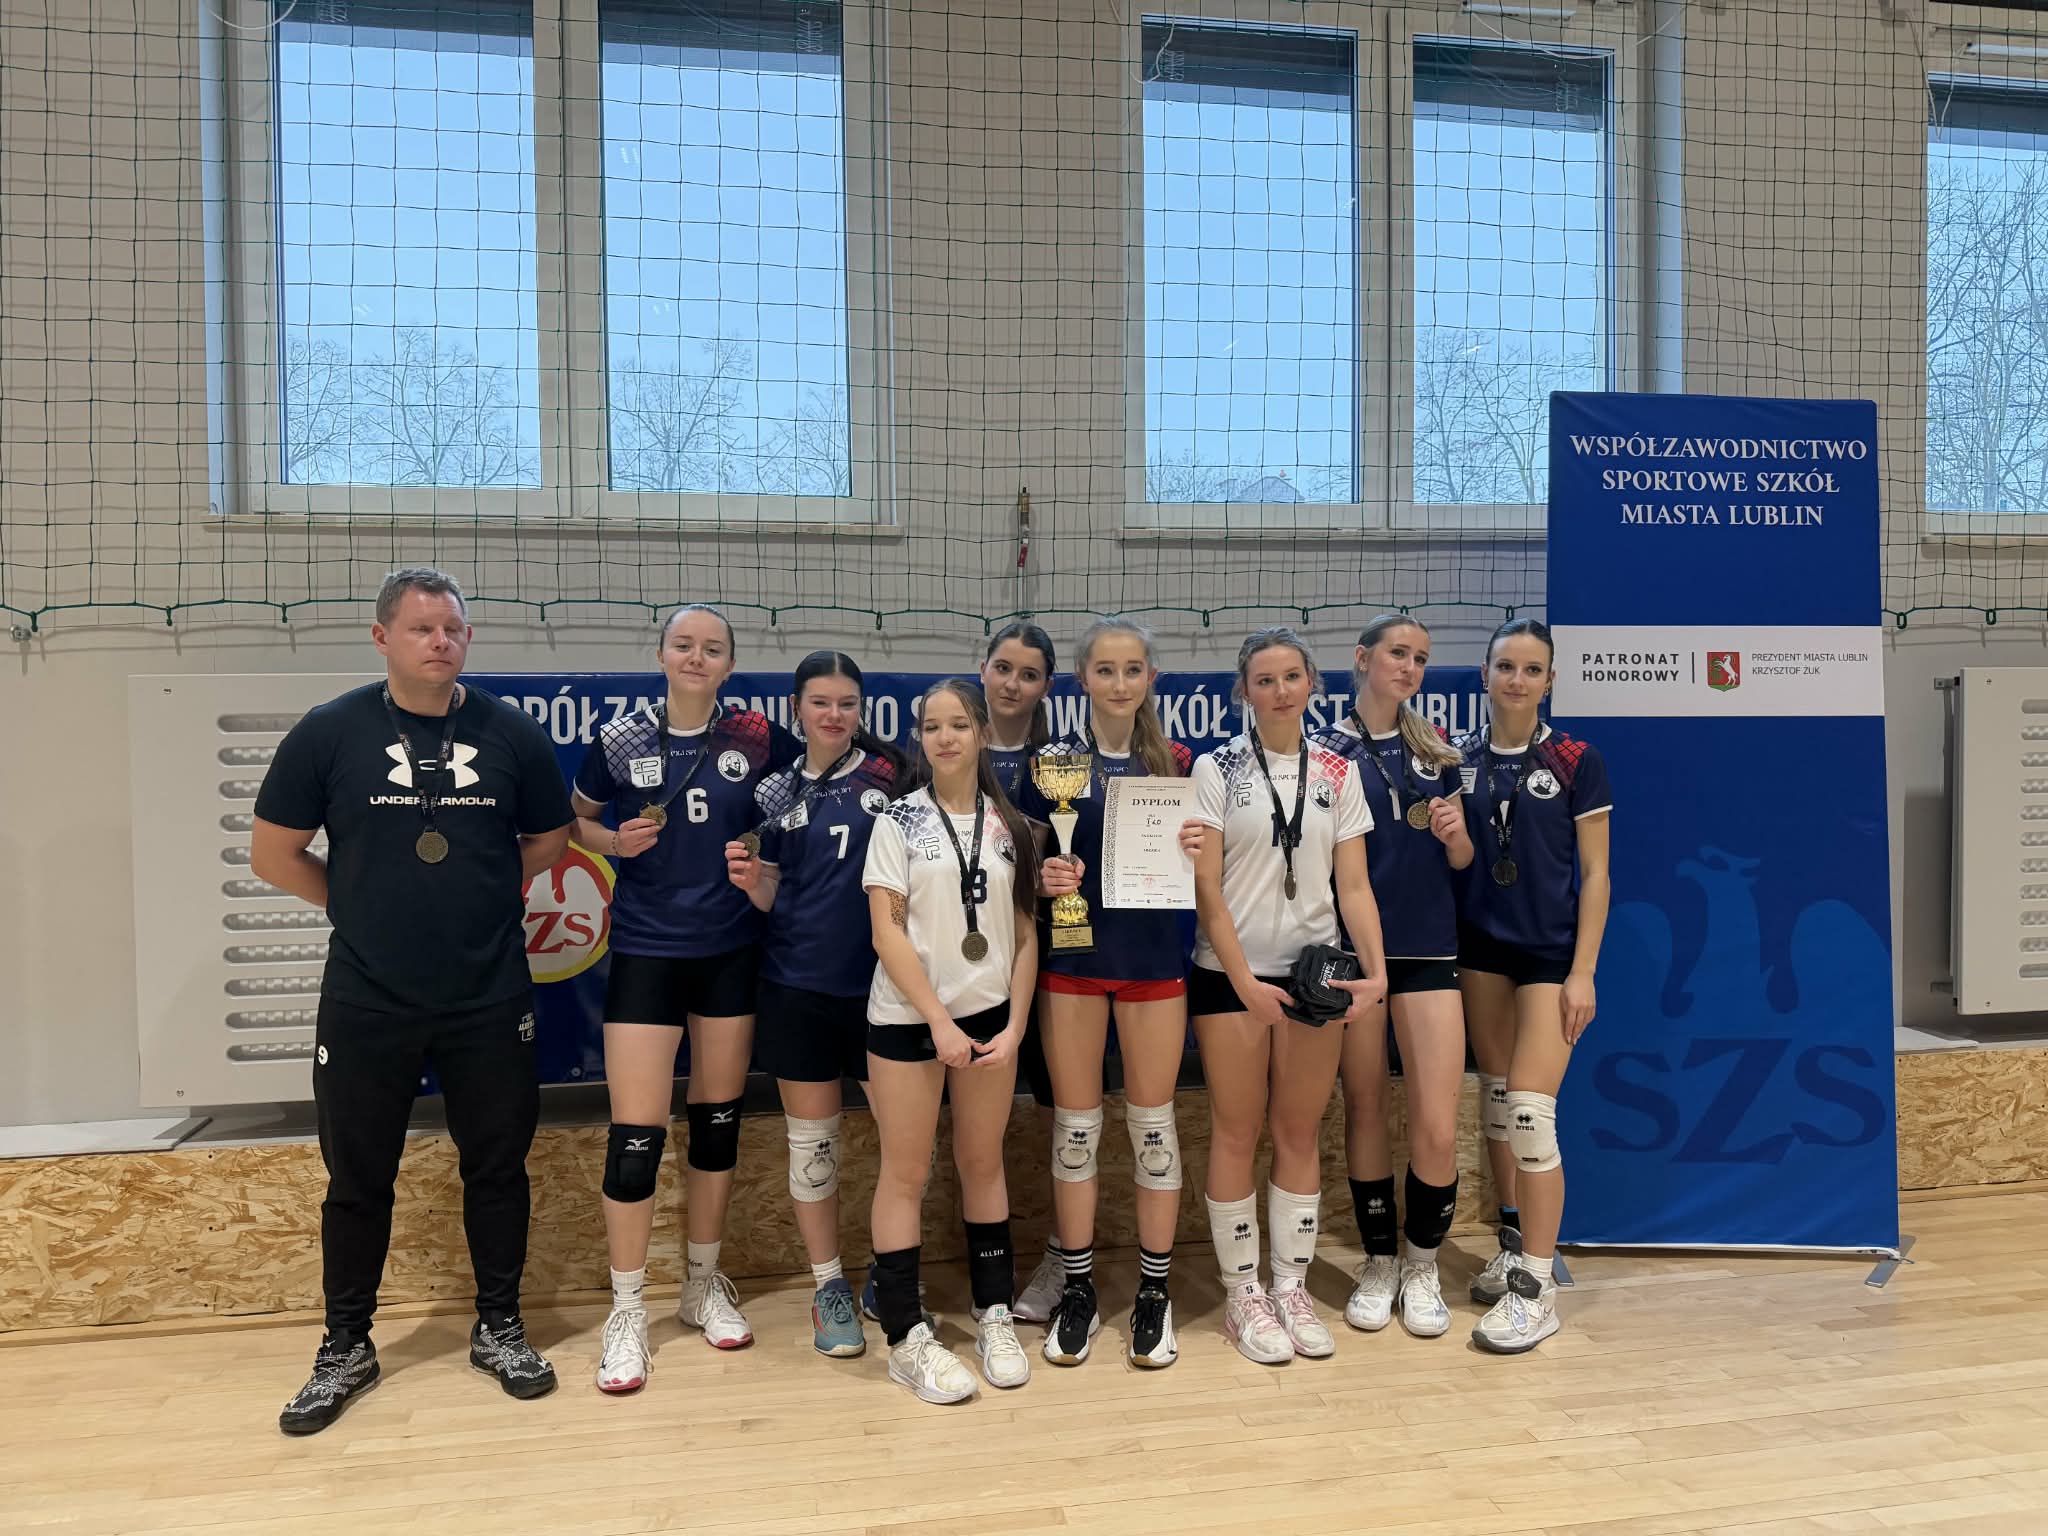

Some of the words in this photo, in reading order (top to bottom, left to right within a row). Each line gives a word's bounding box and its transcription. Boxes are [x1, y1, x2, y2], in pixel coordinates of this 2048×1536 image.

[1569, 432, 1867, 460] WSPÓŁZAWODNICTWO
[1601, 470, 1748, 492] SPORTOWE
[1756, 467, 1840, 493] SZKÓŁ
[1620, 504, 1721, 525] MIASTA
[1728, 505, 1824, 526] LUBLIN
[1582, 653, 1680, 665] PATRONAT
[1751, 653, 1801, 662] PREZYDENT
[1803, 653, 1836, 662] MIASTA
[1838, 653, 1868, 662] LUBLIN
[1582, 670, 1680, 682] HONOROWY
[1752, 666, 1801, 675] KRZYSZTOF
[437, 797, 497, 807] RMOUR
[686, 787, 709, 823] 6
[1132, 798, 1182, 807] DYPLOM
[829, 824, 850, 860] 7
[1588, 1037, 1887, 1165] SZS
[980, 1249, 1005, 1258] ALLSIX
